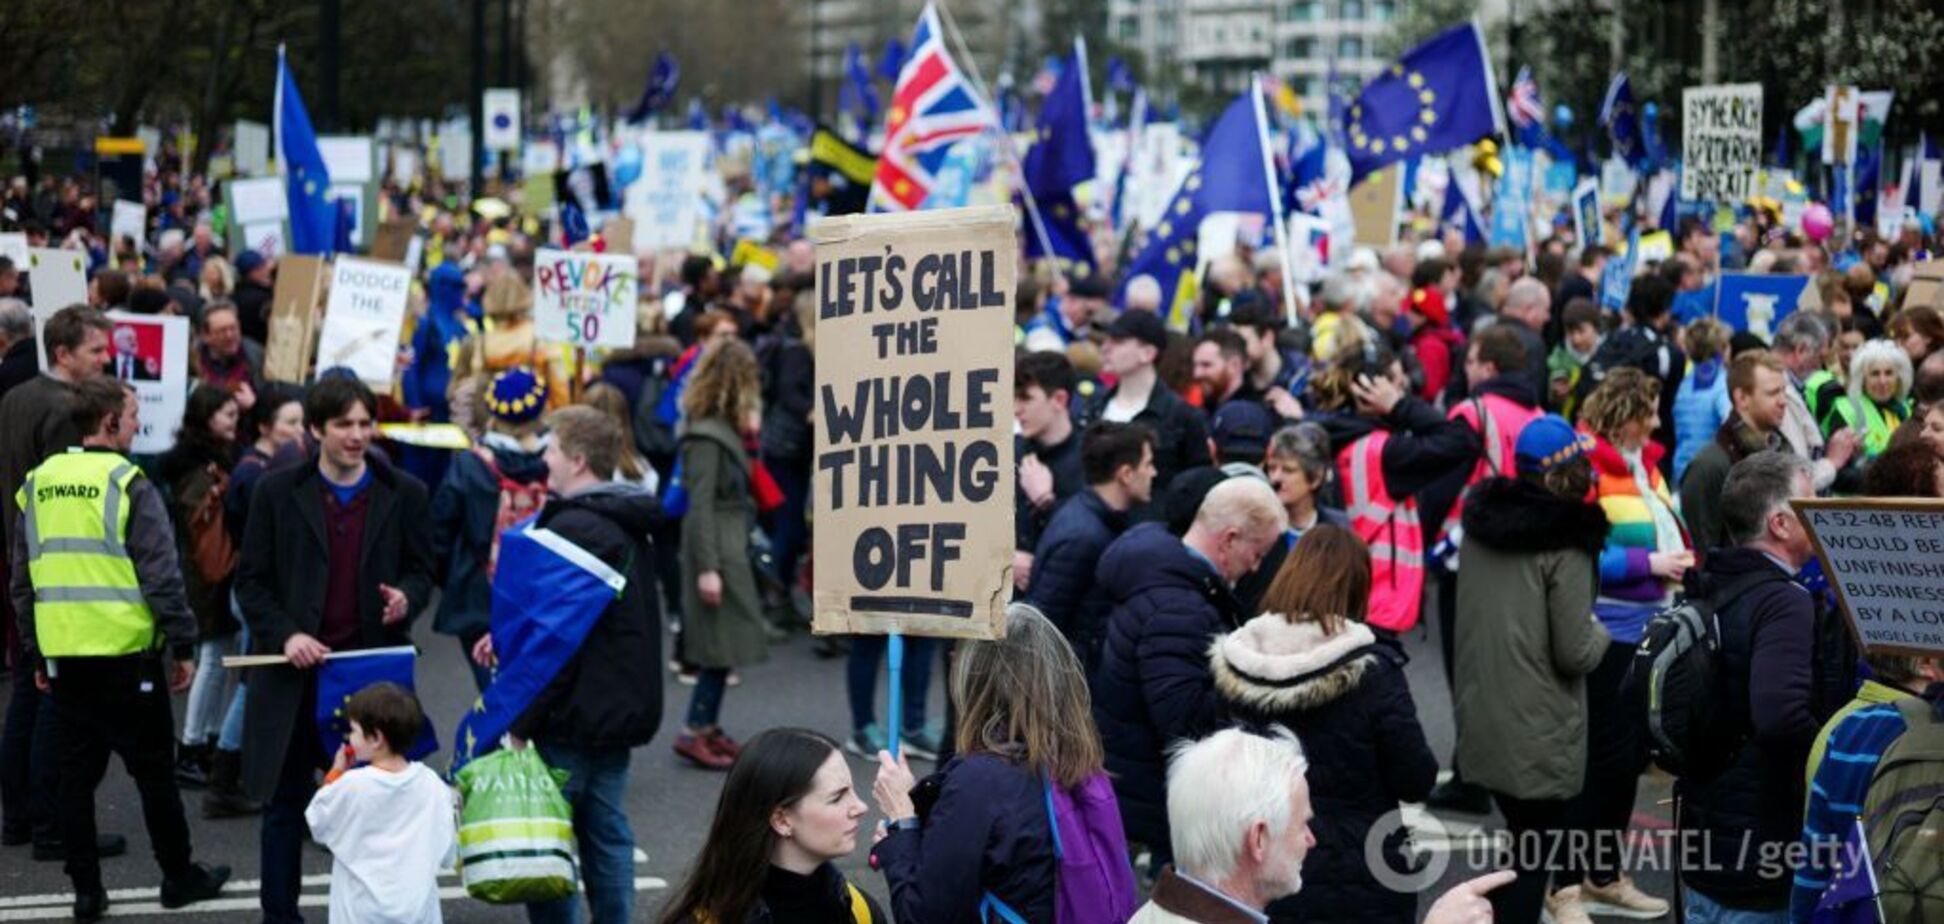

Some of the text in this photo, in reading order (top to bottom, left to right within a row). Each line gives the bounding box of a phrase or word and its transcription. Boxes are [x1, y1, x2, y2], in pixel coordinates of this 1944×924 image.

[339, 267, 404, 293] DODGE
[538, 259, 637, 307] REVOKE
[820, 244, 1006, 320] LET'S CALL
[352, 292, 383, 313] THE
[566, 312, 600, 342] 50
[871, 316, 939, 360] THE
[820, 367, 999, 446] WHOLE
[818, 439, 999, 512] THING
[1814, 512, 1944, 530] A 52-48 REF
[852, 522, 967, 592] OFF
[1822, 535, 1944, 554] WOULD BE
[1857, 607, 1944, 626] BY A LO
[1864, 629, 1912, 643] NIGEL
